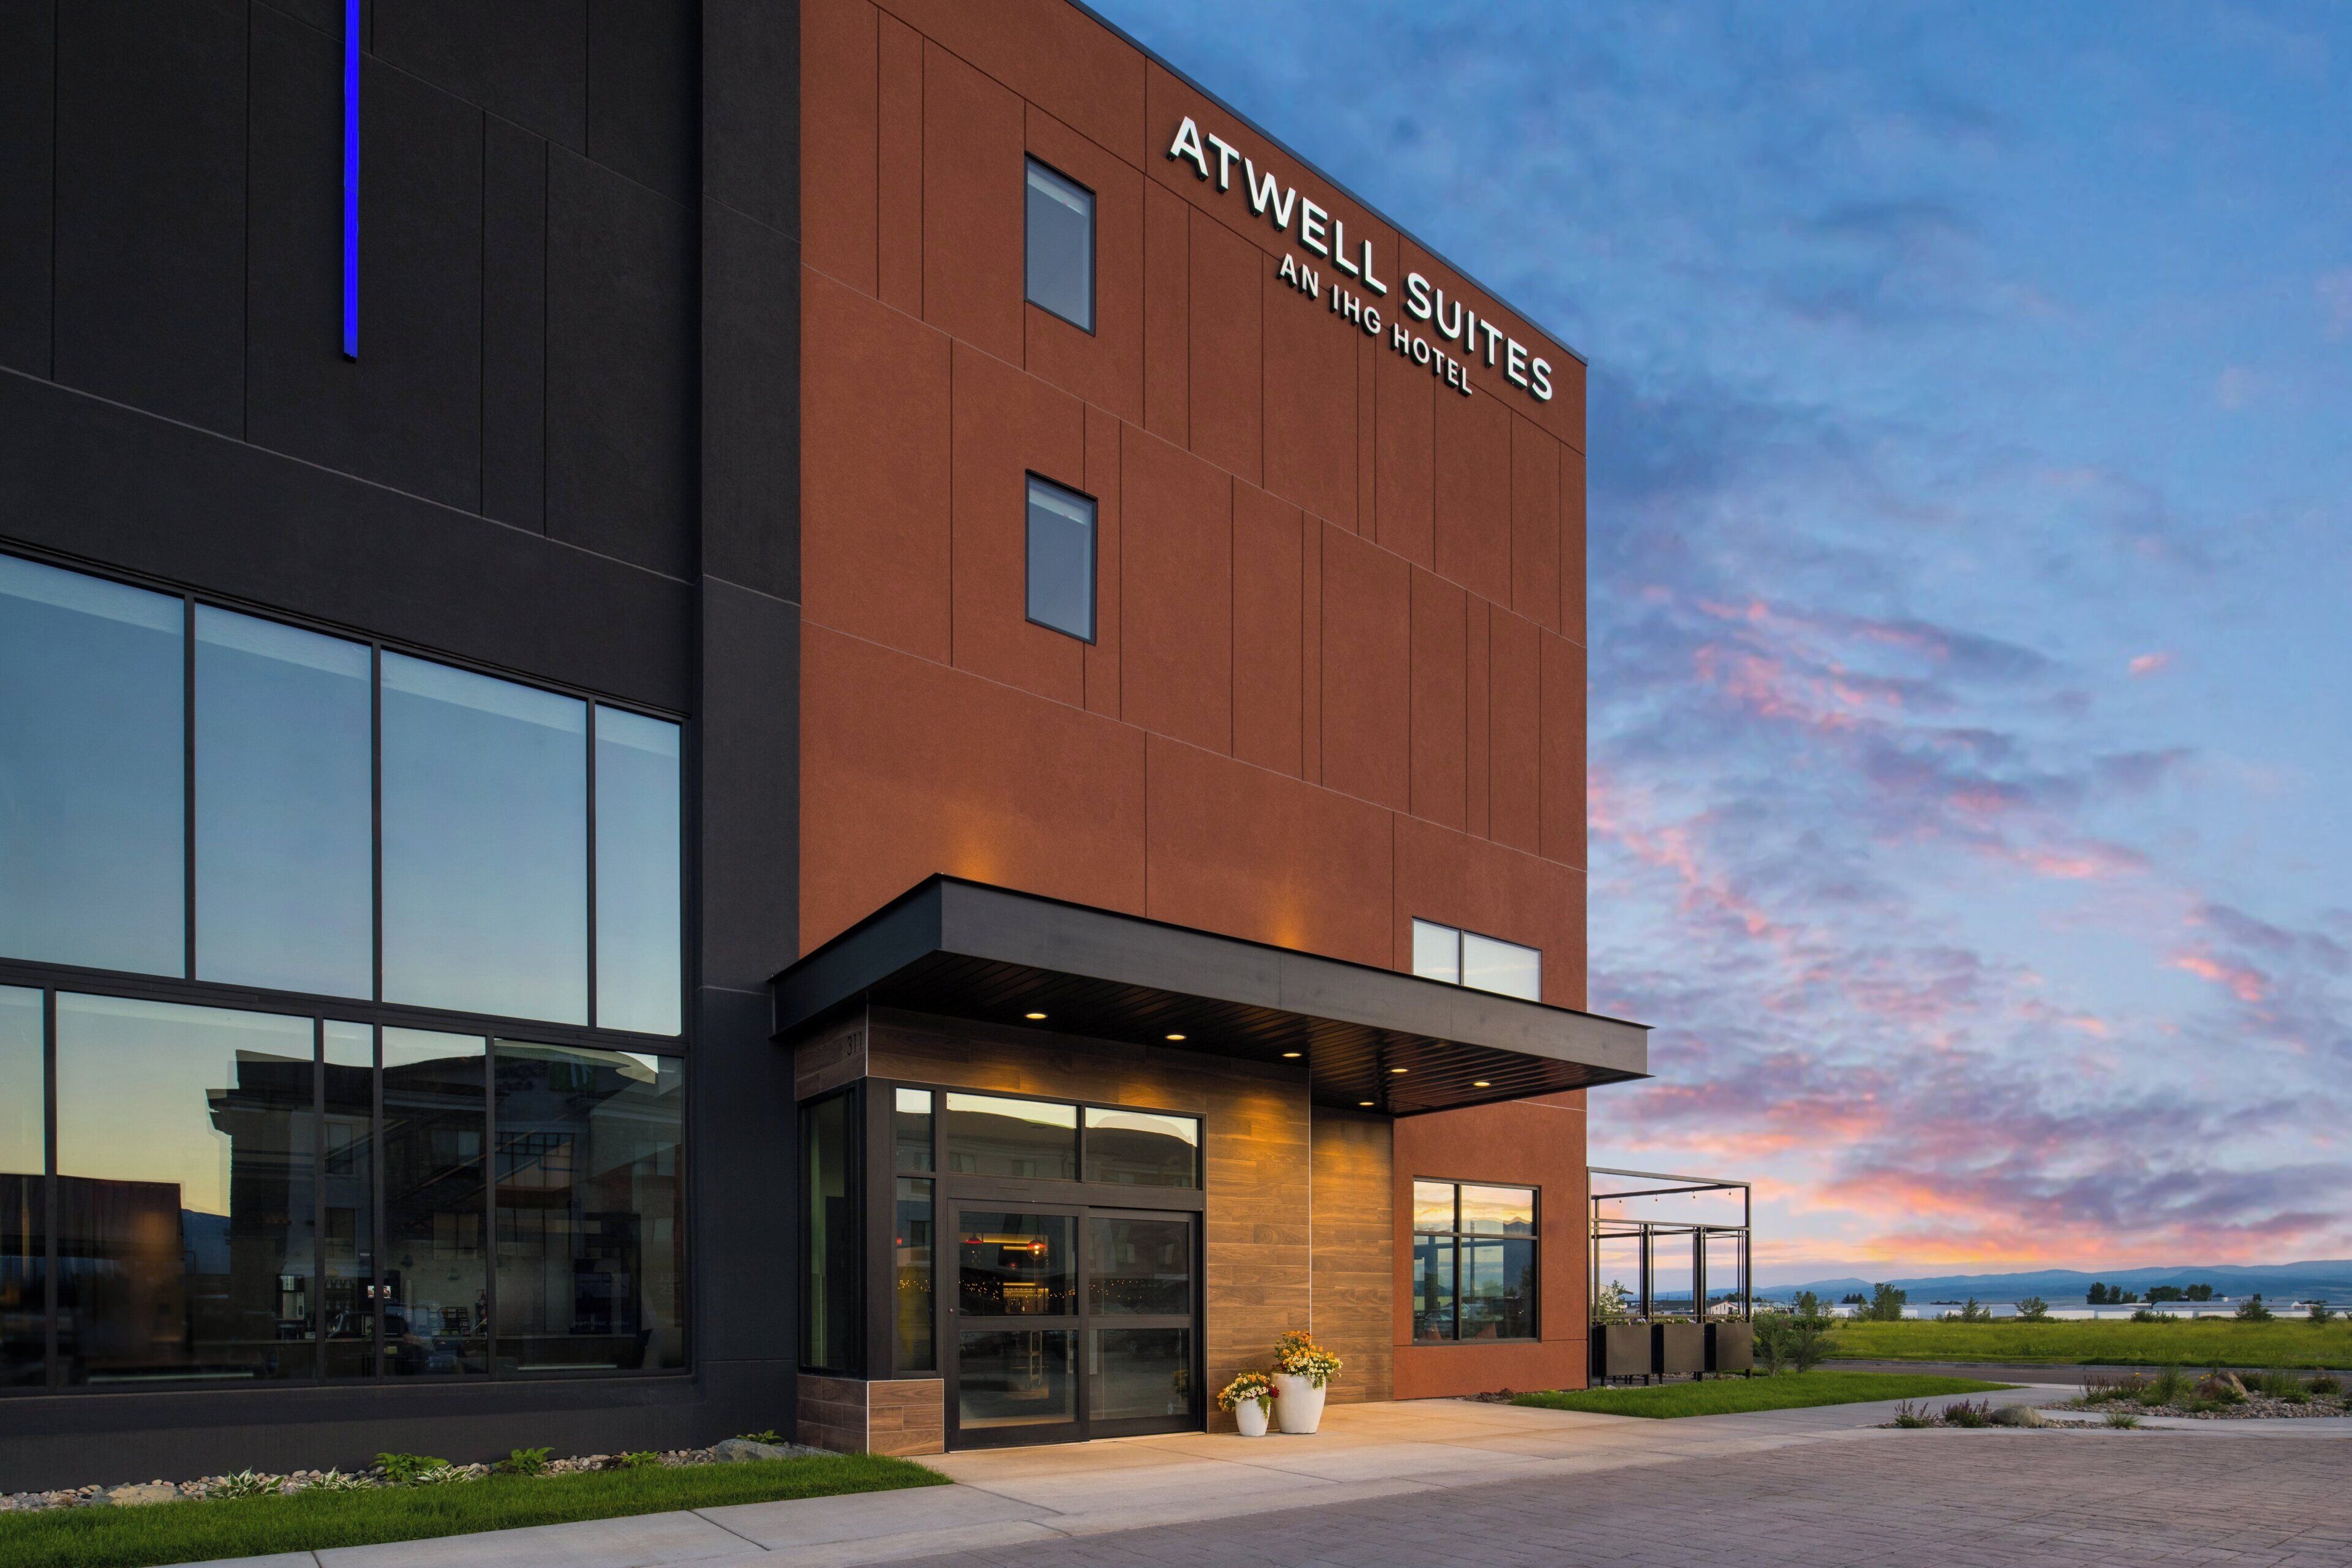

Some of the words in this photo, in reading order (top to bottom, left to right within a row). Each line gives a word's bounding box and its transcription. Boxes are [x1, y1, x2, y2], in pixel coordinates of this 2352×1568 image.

[1167, 116, 1387, 296] ATWELL
[1407, 272, 1552, 401] SUITES
[1278, 252, 1318, 300] AN
[1330, 284, 1381, 336] IHG
[1390, 322, 1472, 396] HOTEL
[846, 1031, 862, 1055] 311
